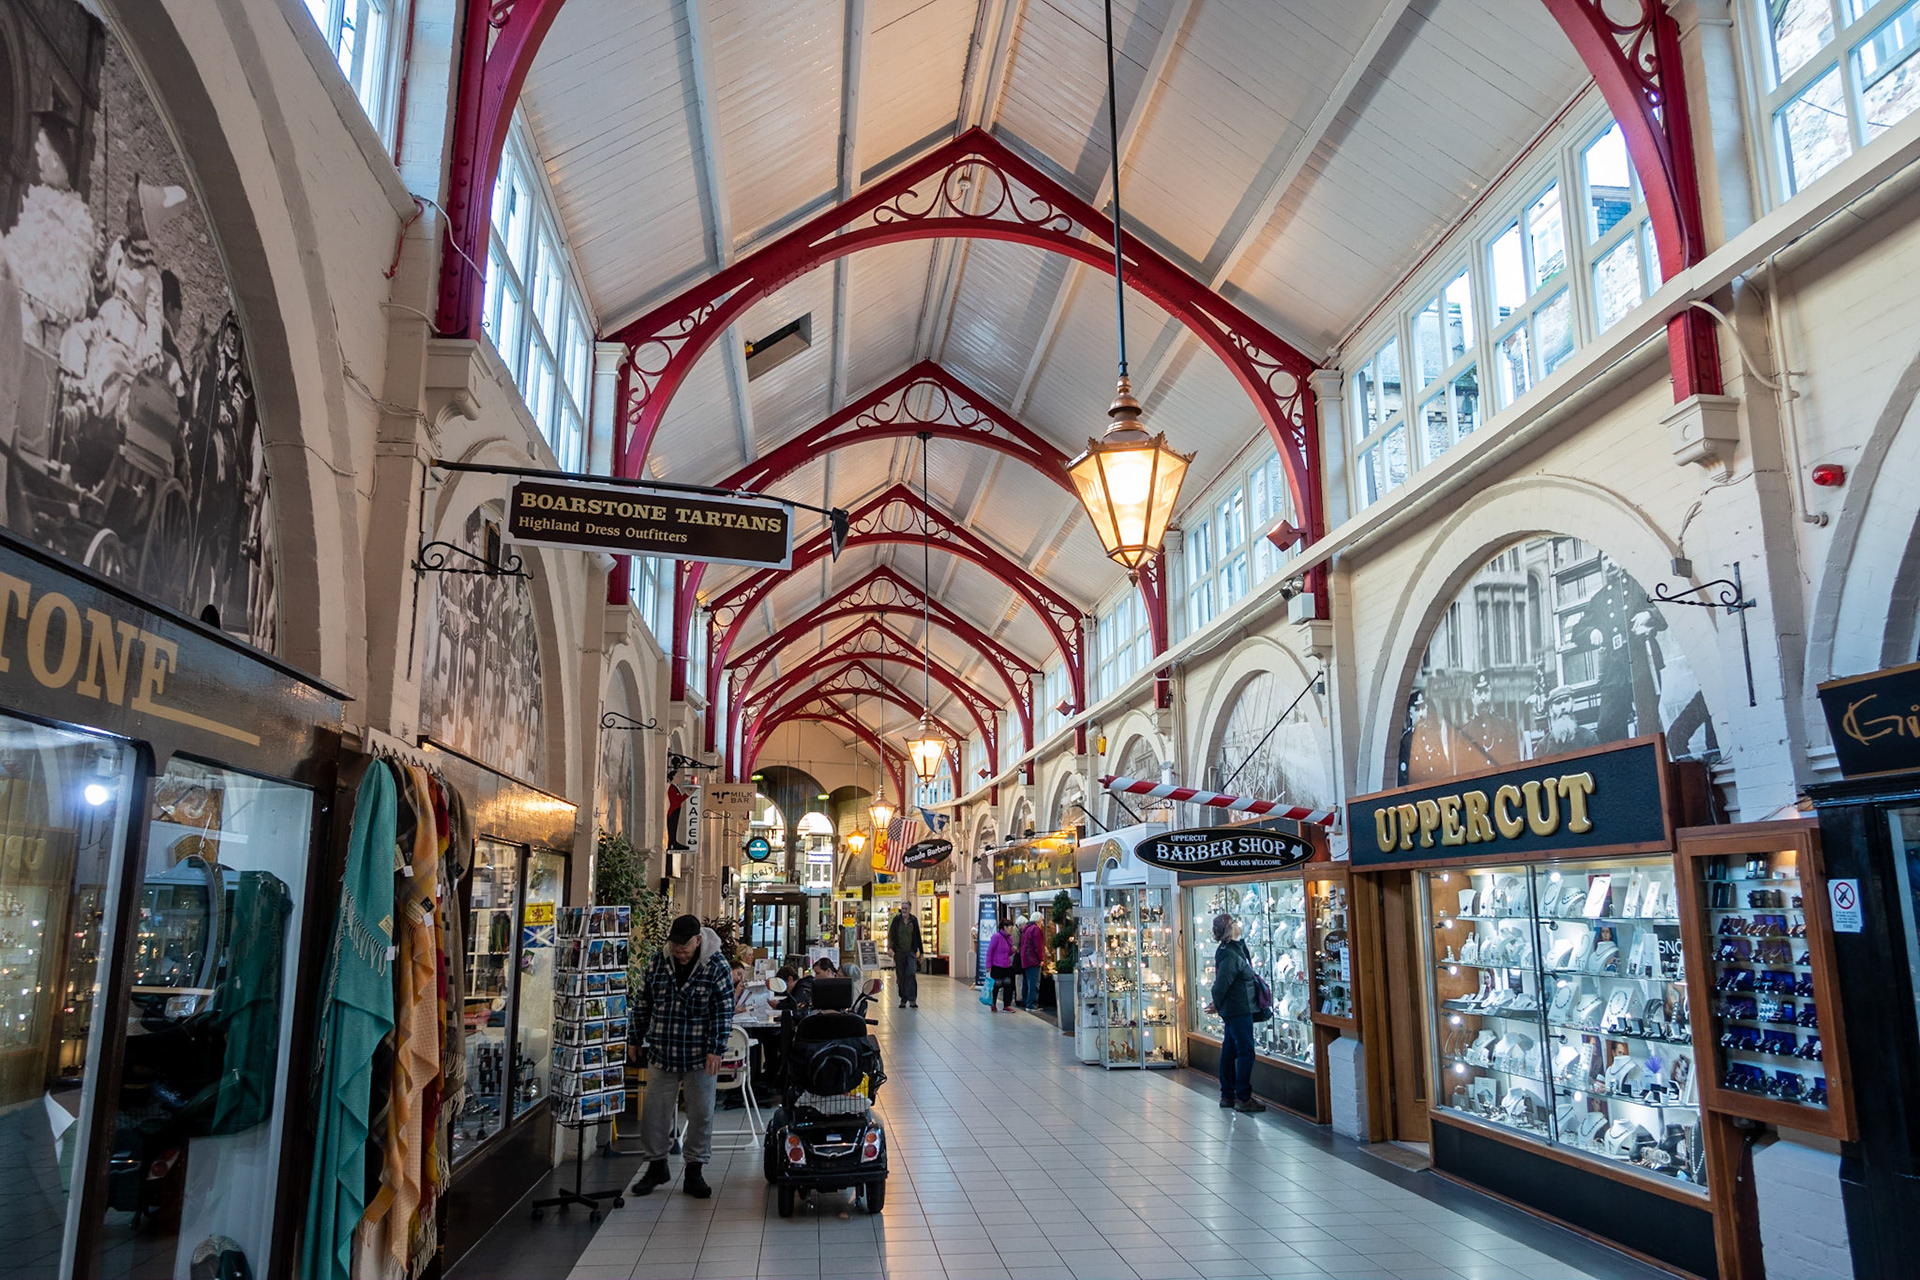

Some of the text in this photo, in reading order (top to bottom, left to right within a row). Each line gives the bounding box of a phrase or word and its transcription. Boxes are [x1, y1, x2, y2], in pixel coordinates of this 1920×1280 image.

[520, 492, 782, 534] BOARSTONE TARTANS
[518, 516, 688, 543] Highland Dress Outfitters
[688, 796, 698, 838] CAFE
[1374, 771, 1595, 853] UPPERCUT
[1156, 838, 1286, 862] BARBER SHOP
[1170, 834, 1207, 842] UPPERCUT
[903, 843, 952, 864] Arcade Barbers
[1251, 858, 1281, 866] WELCOME
